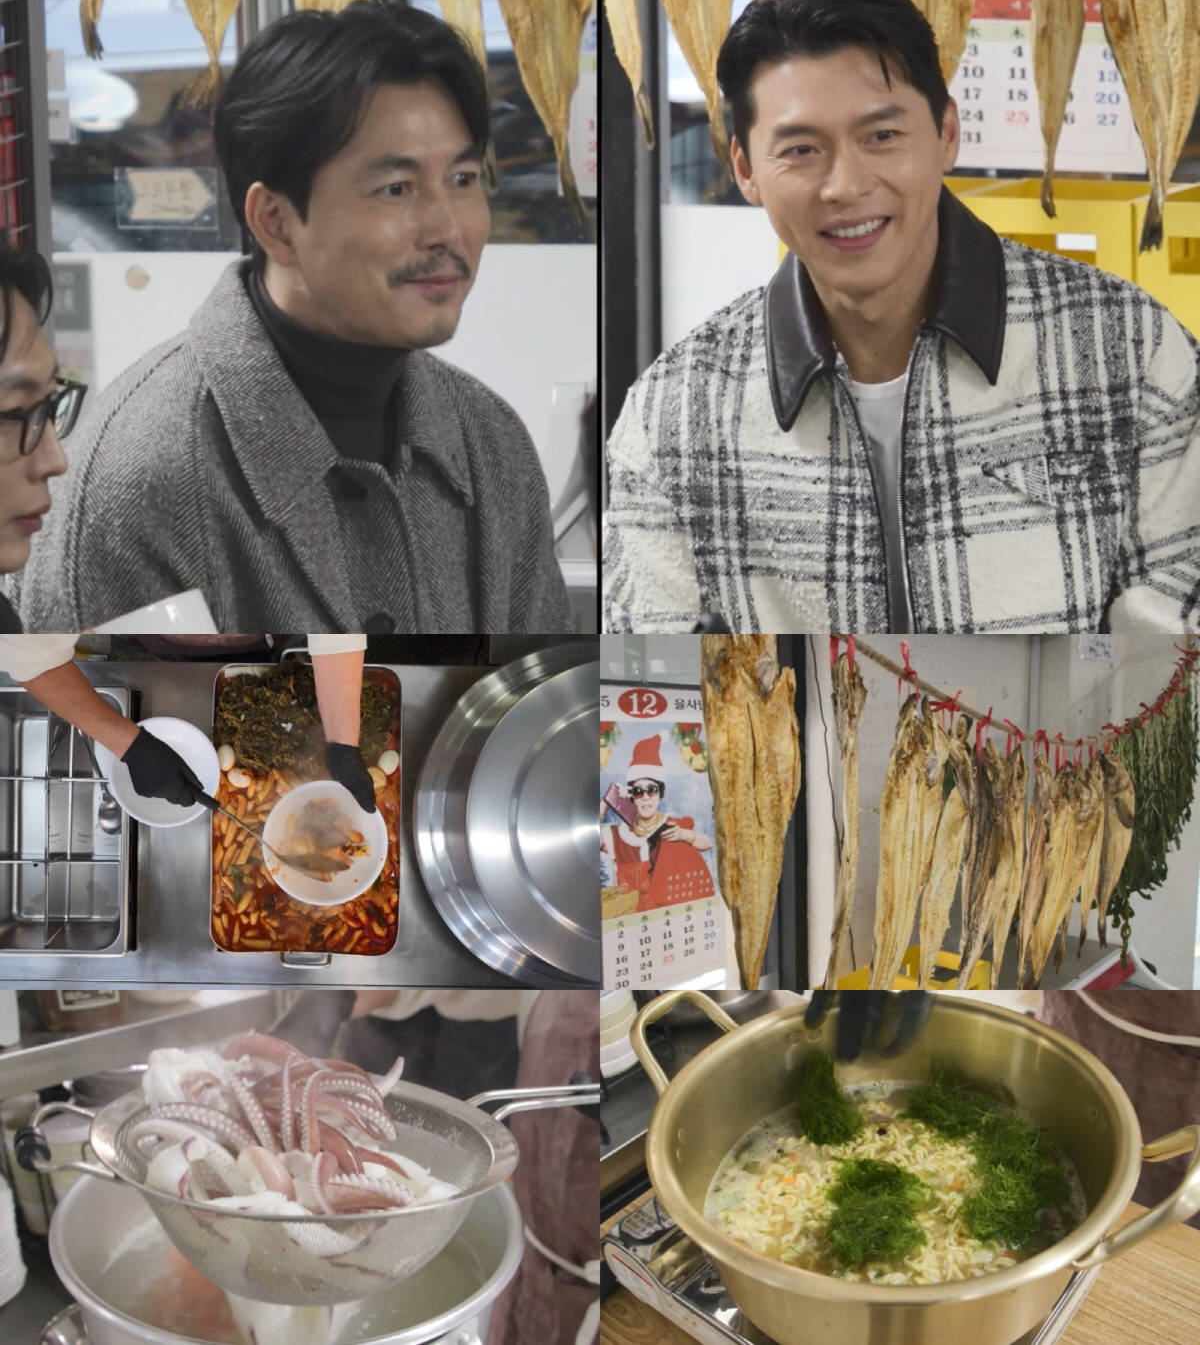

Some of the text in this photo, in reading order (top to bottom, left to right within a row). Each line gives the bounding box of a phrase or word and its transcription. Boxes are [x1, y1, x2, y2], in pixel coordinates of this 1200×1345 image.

[967, 44, 979, 57] 3
[1012, 45, 1024, 58] 4
[961, 66, 1119, 82] 10 11 13
[962, 88, 1121, 105] 17 18 20
[960, 109, 984, 122] 24
[1005, 110, 1030, 124] 25
[1096, 114, 1120, 127] 27
[961, 132, 983, 144] 31
[629, 692, 658, 715] 12
[617, 930, 624, 939] 2
[641, 924, 648, 933] 3
[664, 919, 670, 927] 4
[685, 914, 692, 922] 5
[617, 919, 714, 951] 9 10 11 12 13
[615, 930, 716, 965] 16 17 18 19 20
[615, 942, 715, 977] 23 24 25 26 27
[614, 972, 652, 990] 30 31
